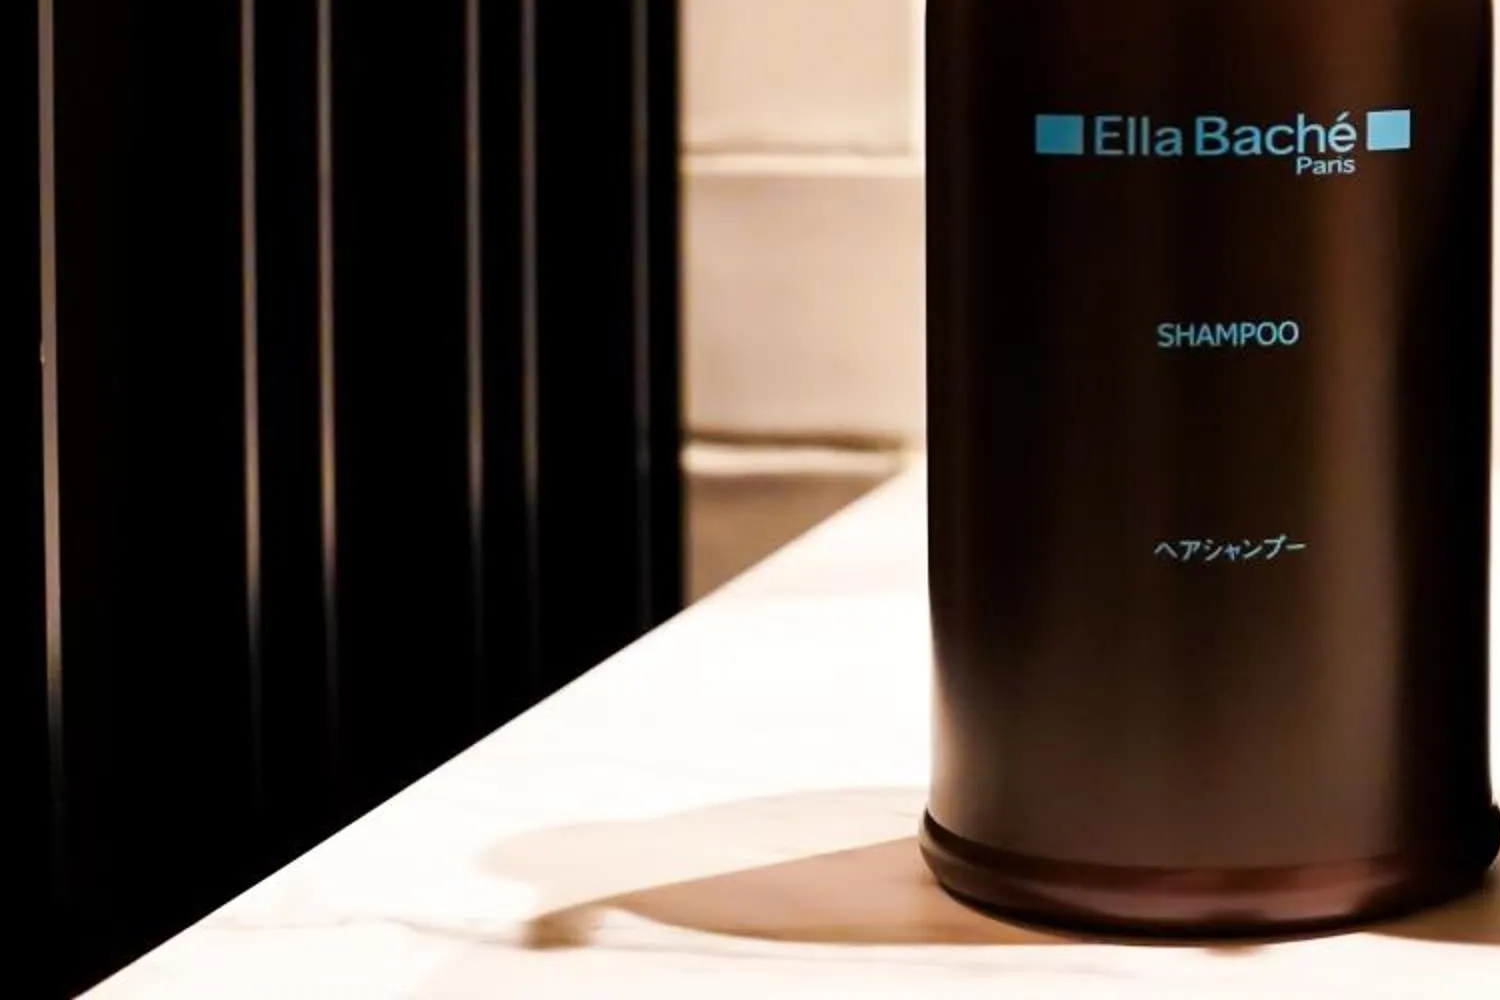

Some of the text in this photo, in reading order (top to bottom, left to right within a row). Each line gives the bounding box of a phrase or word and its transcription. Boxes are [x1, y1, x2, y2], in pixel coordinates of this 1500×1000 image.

[1093, 112, 1358, 158] Ella Baché
[1296, 157, 1356, 176] Paris
[1156, 320, 1300, 349] SHAMPOO
[1153, 535, 1307, 562] ヘアシャンプー
